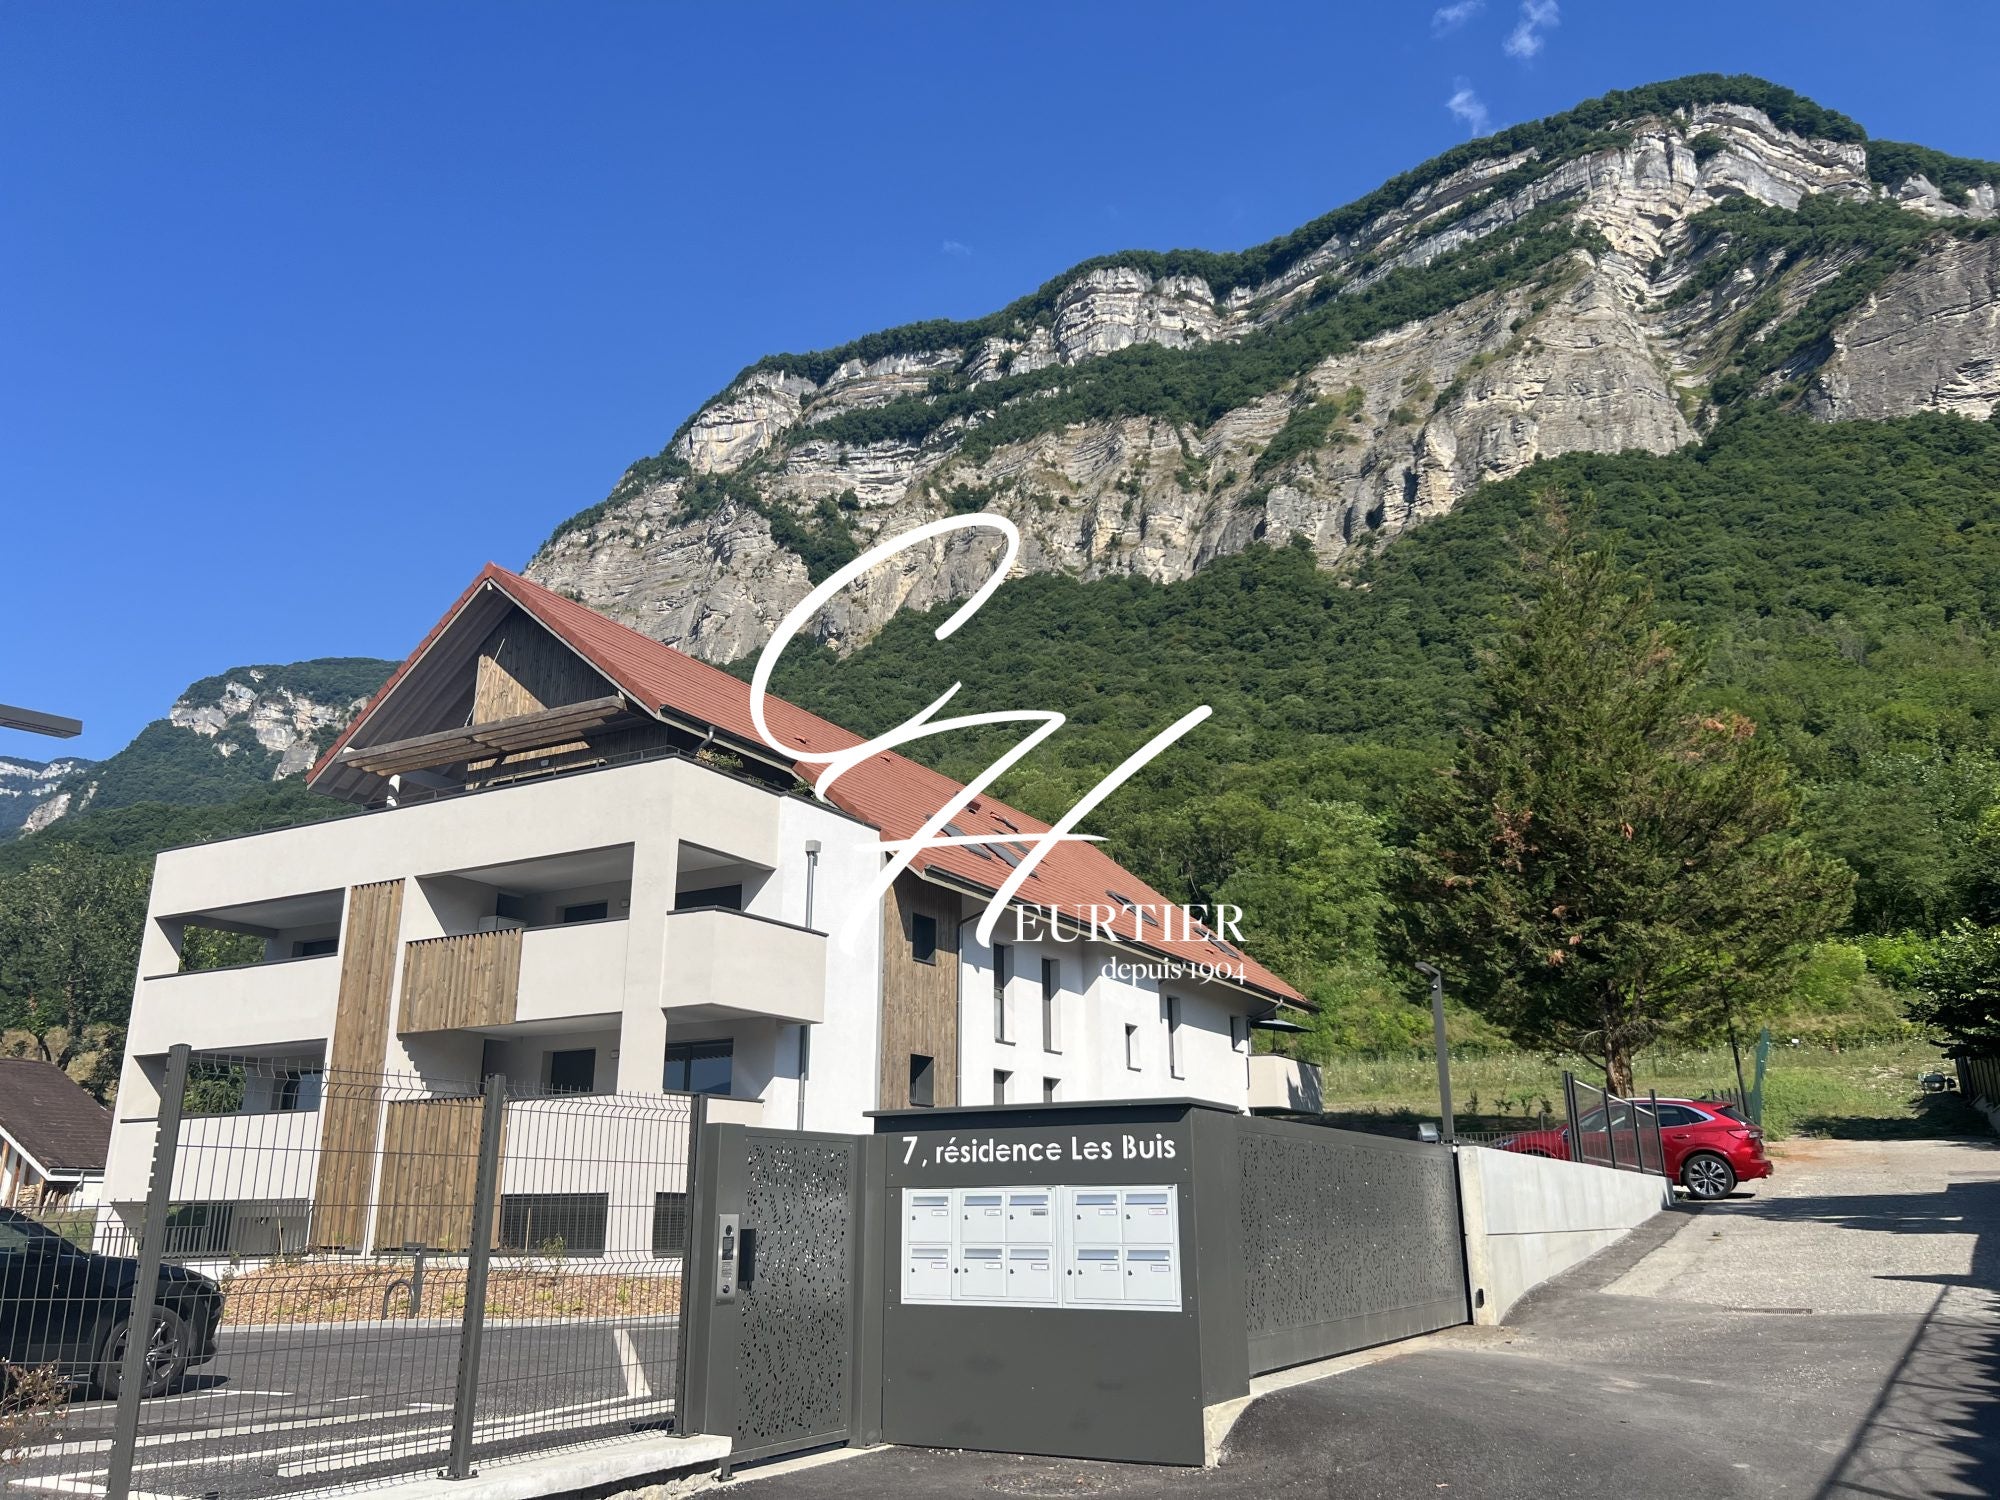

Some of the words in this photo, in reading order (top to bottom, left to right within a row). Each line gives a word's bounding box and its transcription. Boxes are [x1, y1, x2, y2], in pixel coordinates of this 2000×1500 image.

[935, 1137, 1062, 1164] résidence
[1071, 1136, 1113, 1161] Les
[1122, 1133, 1176, 1160] Buis
